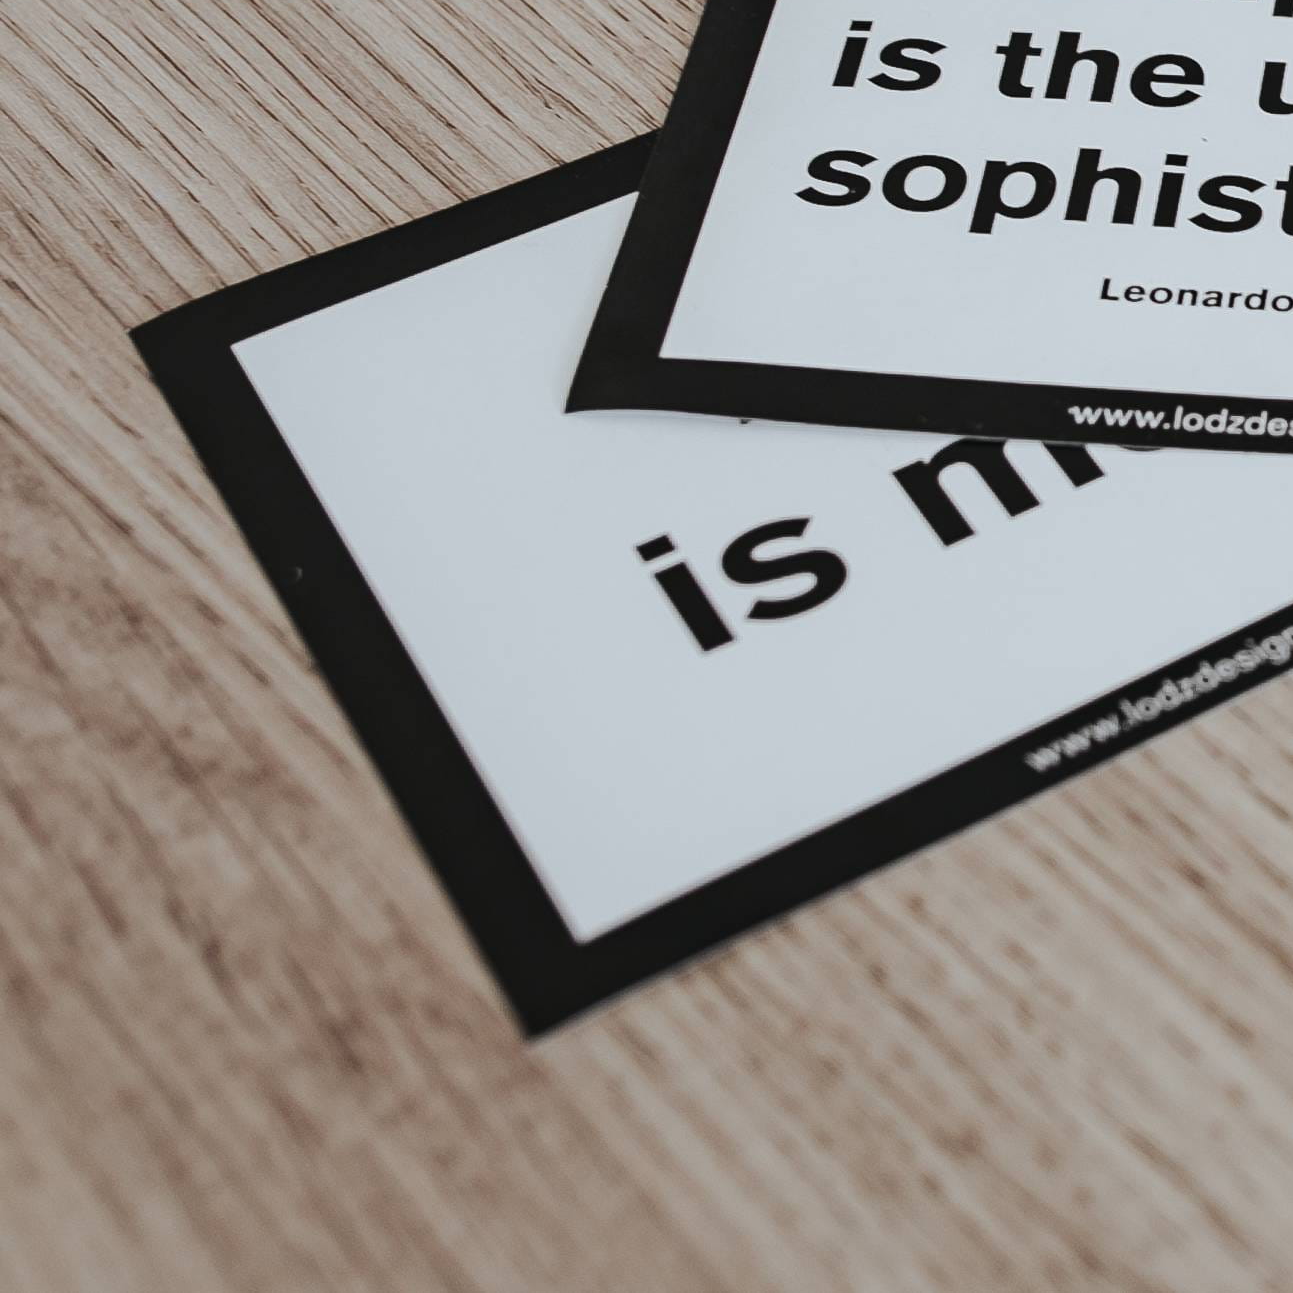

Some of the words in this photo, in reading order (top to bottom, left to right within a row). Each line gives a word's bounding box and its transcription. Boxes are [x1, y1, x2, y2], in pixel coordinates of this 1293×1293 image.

[830, 19, 948, 93] is
[994, 29, 1206, 109] the
[635, 516, 848, 653] is
